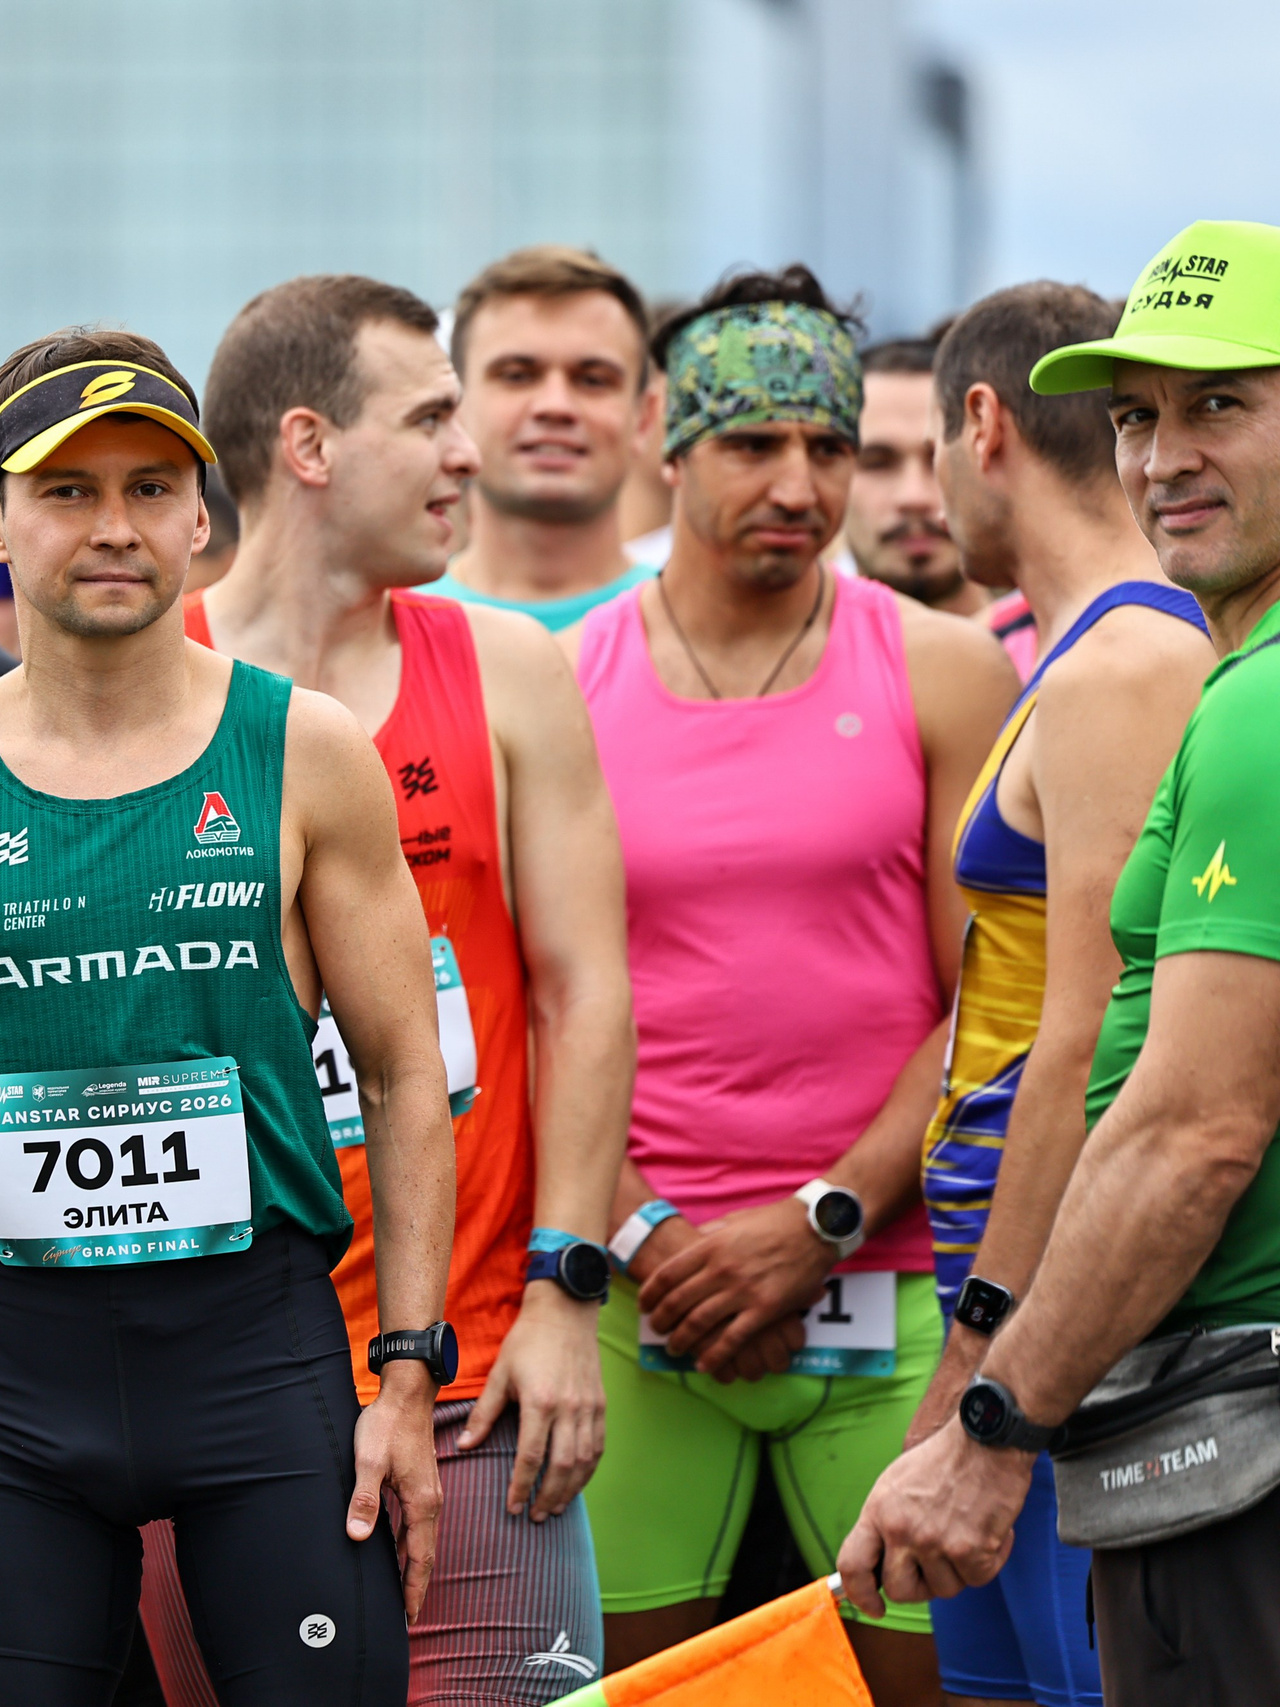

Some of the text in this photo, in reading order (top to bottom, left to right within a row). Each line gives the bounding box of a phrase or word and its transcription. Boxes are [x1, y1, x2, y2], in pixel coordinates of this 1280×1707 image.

[1185, 255, 1229, 276] STAR
[1131, 291, 1214, 314] СУДЬЯ
[186, 846, 255, 860] ЛОКОМОТИВ
[3, 915, 46, 931] CENTER
[98, 1081, 127, 1090] Legenda
[137, 1076, 160, 1087] MIR
[88, 1100, 173, 1120] СИРИУС
[180, 1093, 232, 1112] 2026
[23, 1130, 200, 1193] 7011
[63, 1201, 169, 1229] ЭЛИТА
[82, 1243, 142, 1258] GRAND
[148, 1238, 200, 1253] FINAL
